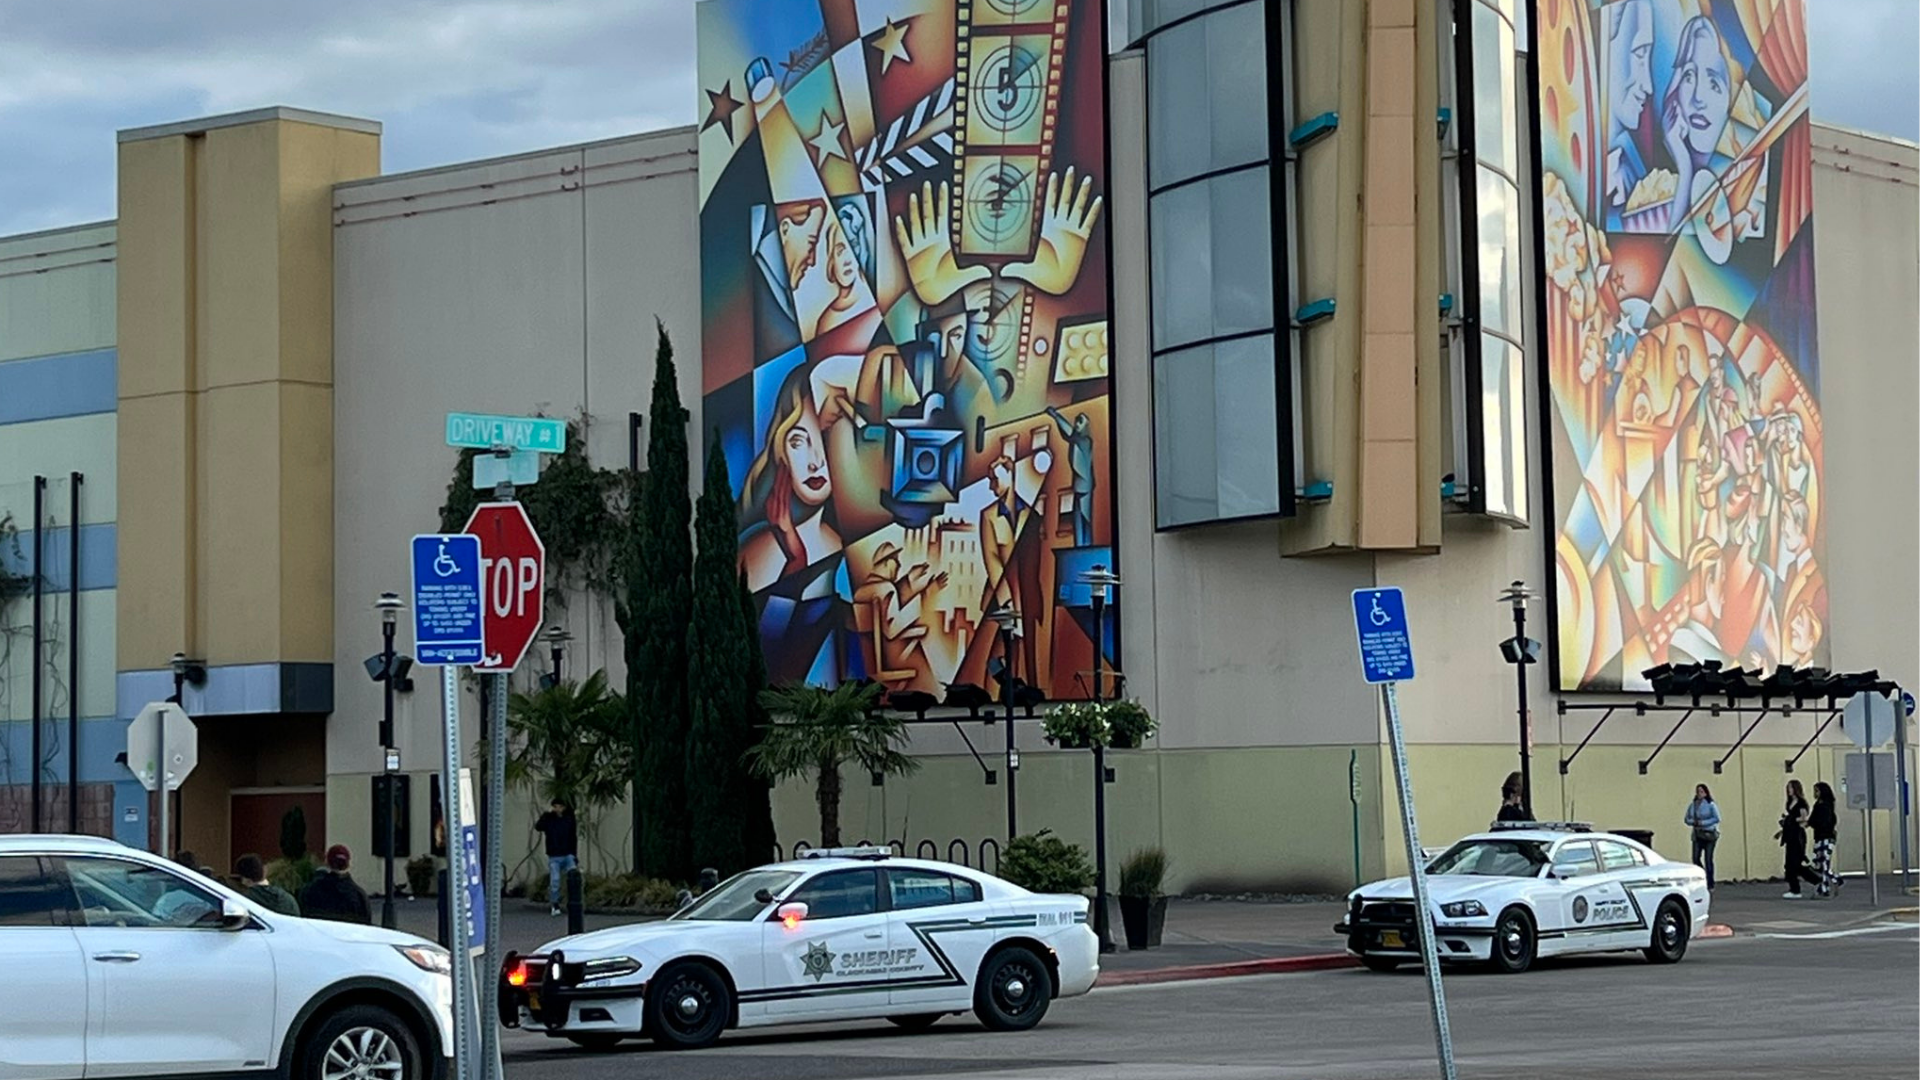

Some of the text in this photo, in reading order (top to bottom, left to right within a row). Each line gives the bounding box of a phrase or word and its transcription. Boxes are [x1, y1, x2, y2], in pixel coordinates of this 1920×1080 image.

[997, 67, 1018, 111] 5
[452, 418, 534, 446] DRIVEWAY
[480, 557, 538, 618] TOP
[1592, 905, 1629, 922] POLICE
[841, 948, 917, 968] SHERIFF
